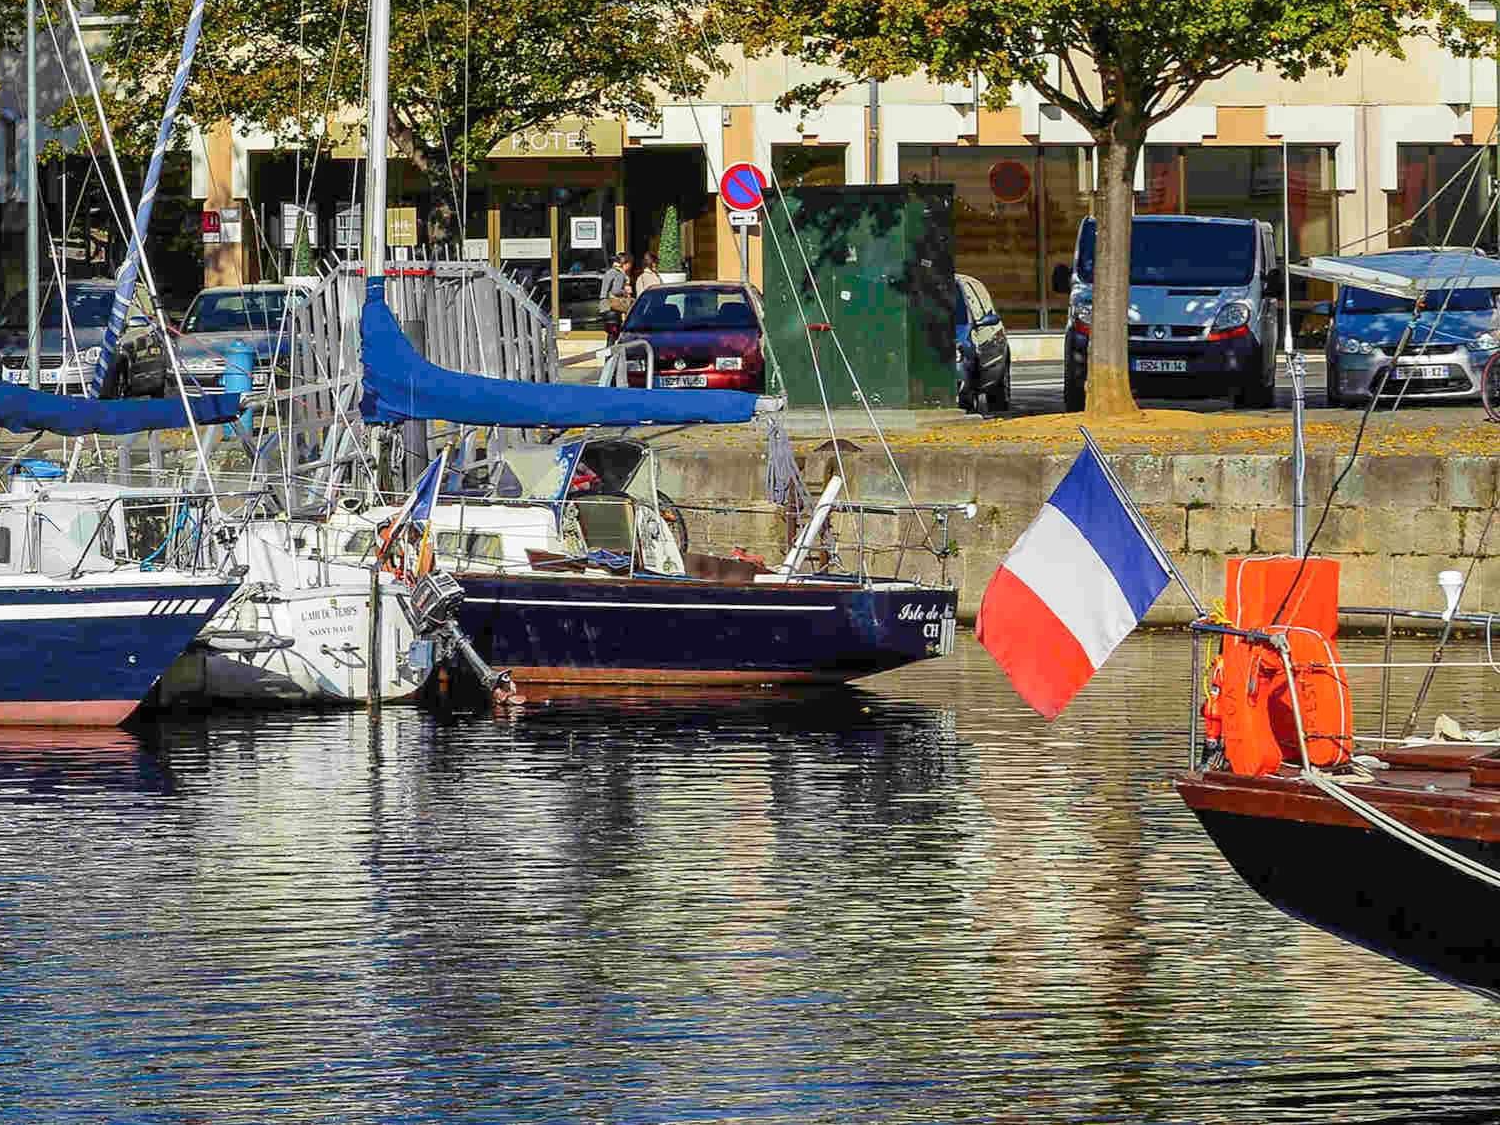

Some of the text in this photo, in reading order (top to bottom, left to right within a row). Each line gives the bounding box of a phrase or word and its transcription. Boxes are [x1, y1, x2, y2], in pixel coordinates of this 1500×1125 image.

[897, 603, 925, 620] Isle
[926, 604, 939, 620] de
[923, 623, 940, 638] CH
